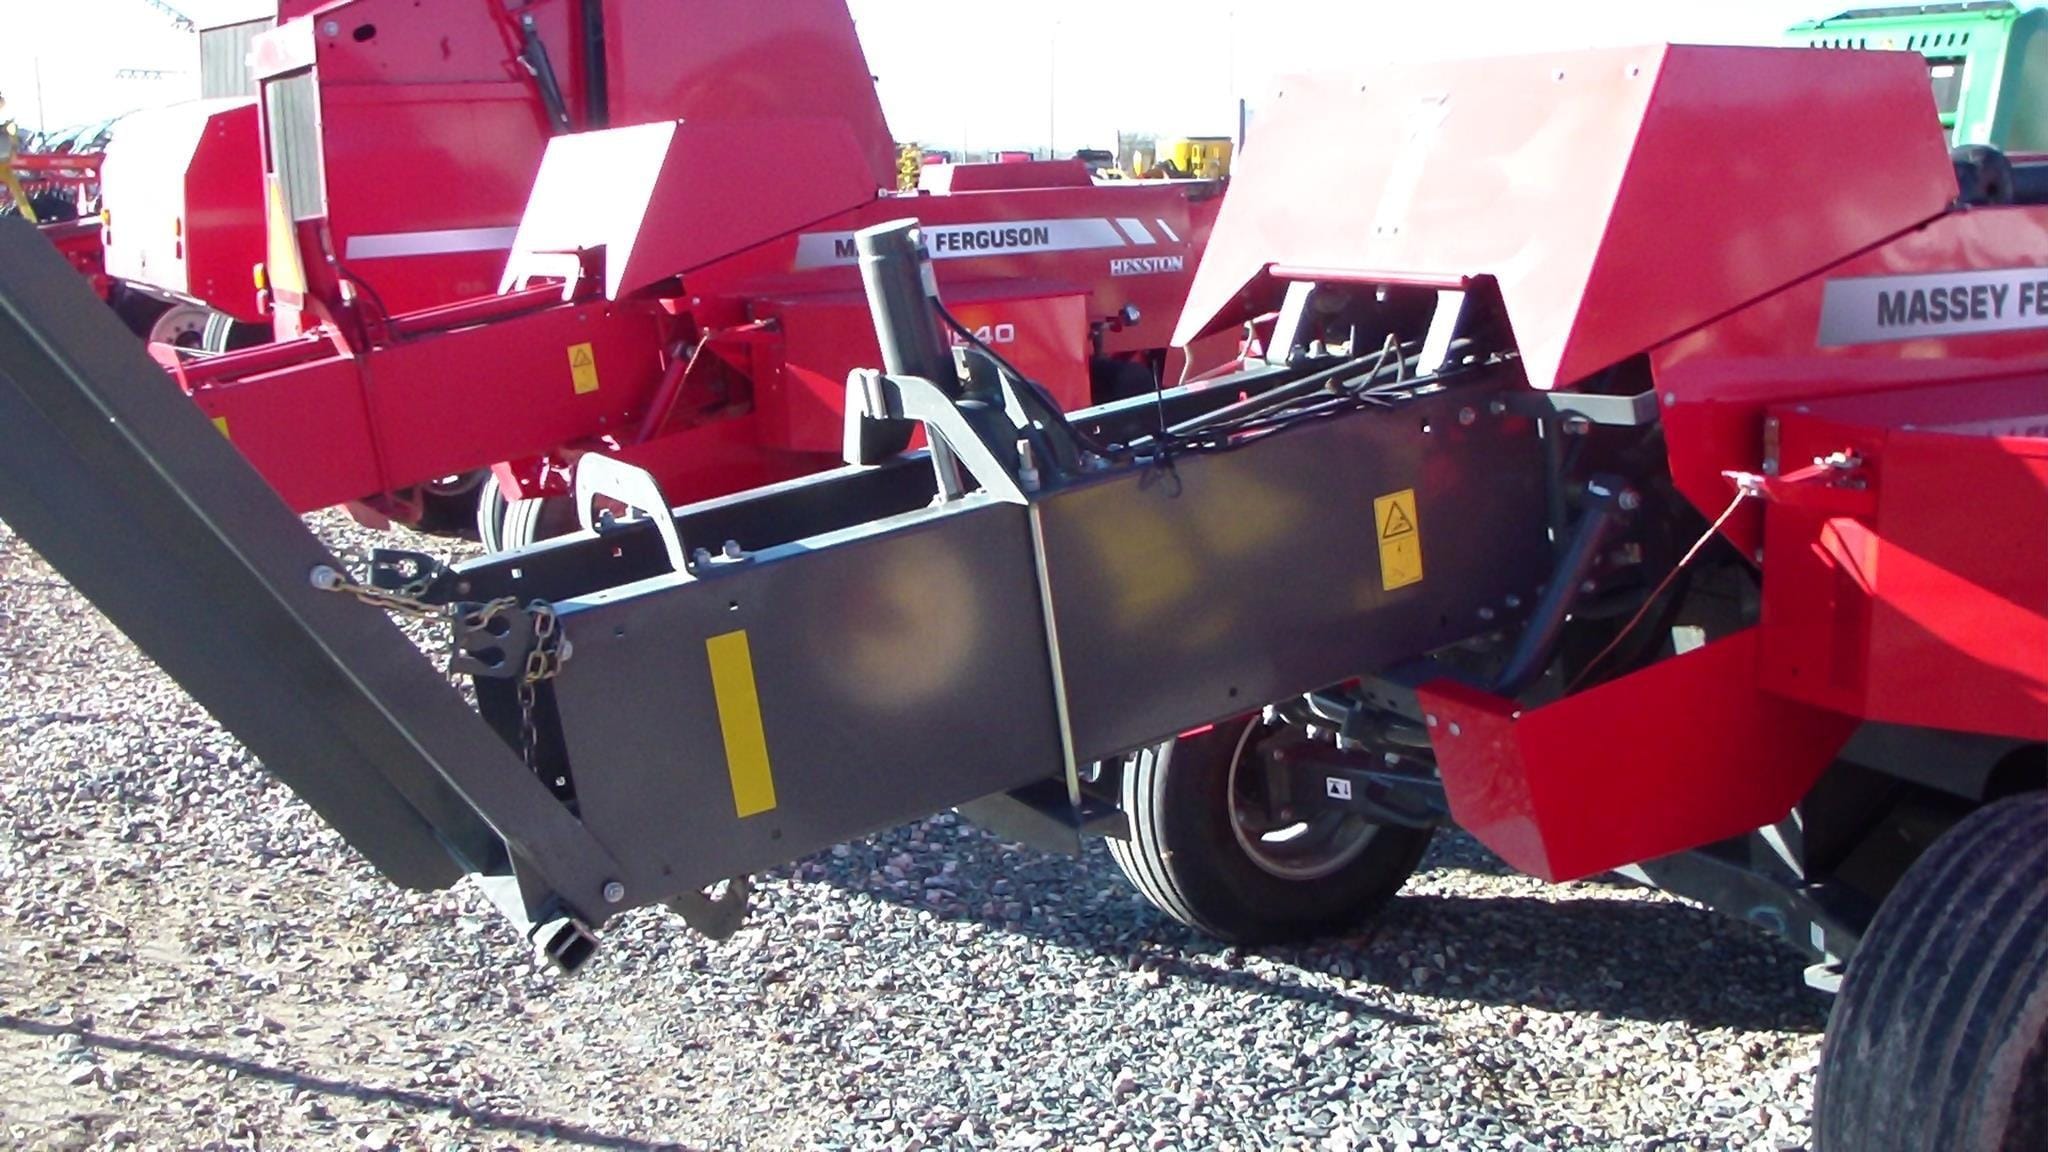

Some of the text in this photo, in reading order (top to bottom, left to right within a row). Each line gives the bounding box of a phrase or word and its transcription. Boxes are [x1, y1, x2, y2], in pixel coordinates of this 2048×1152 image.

[935, 227, 1049, 251] FERGUSON
[1110, 256, 1184, 276] HESSTON
[1877, 284, 2008, 327] MASSEY
